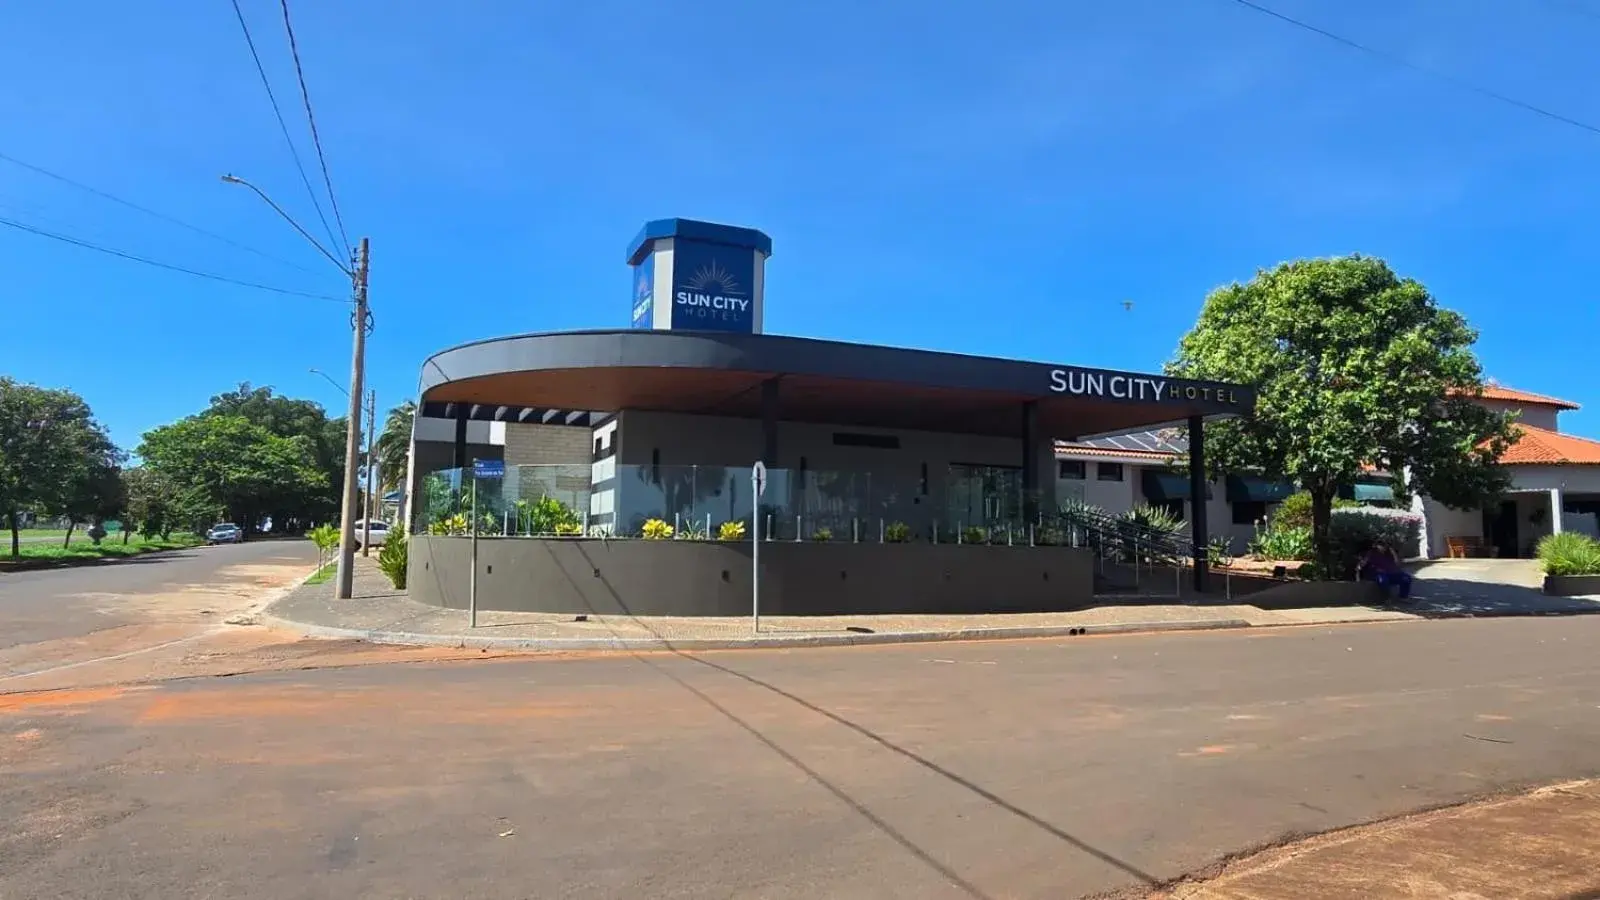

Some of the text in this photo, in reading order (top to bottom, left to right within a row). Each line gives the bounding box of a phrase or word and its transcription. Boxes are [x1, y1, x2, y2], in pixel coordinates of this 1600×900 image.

[677, 292, 749, 311] SUN CITY
[685, 308, 740, 321] HOTEL
[1050, 369, 1239, 403] SUN CITY HOTEL
